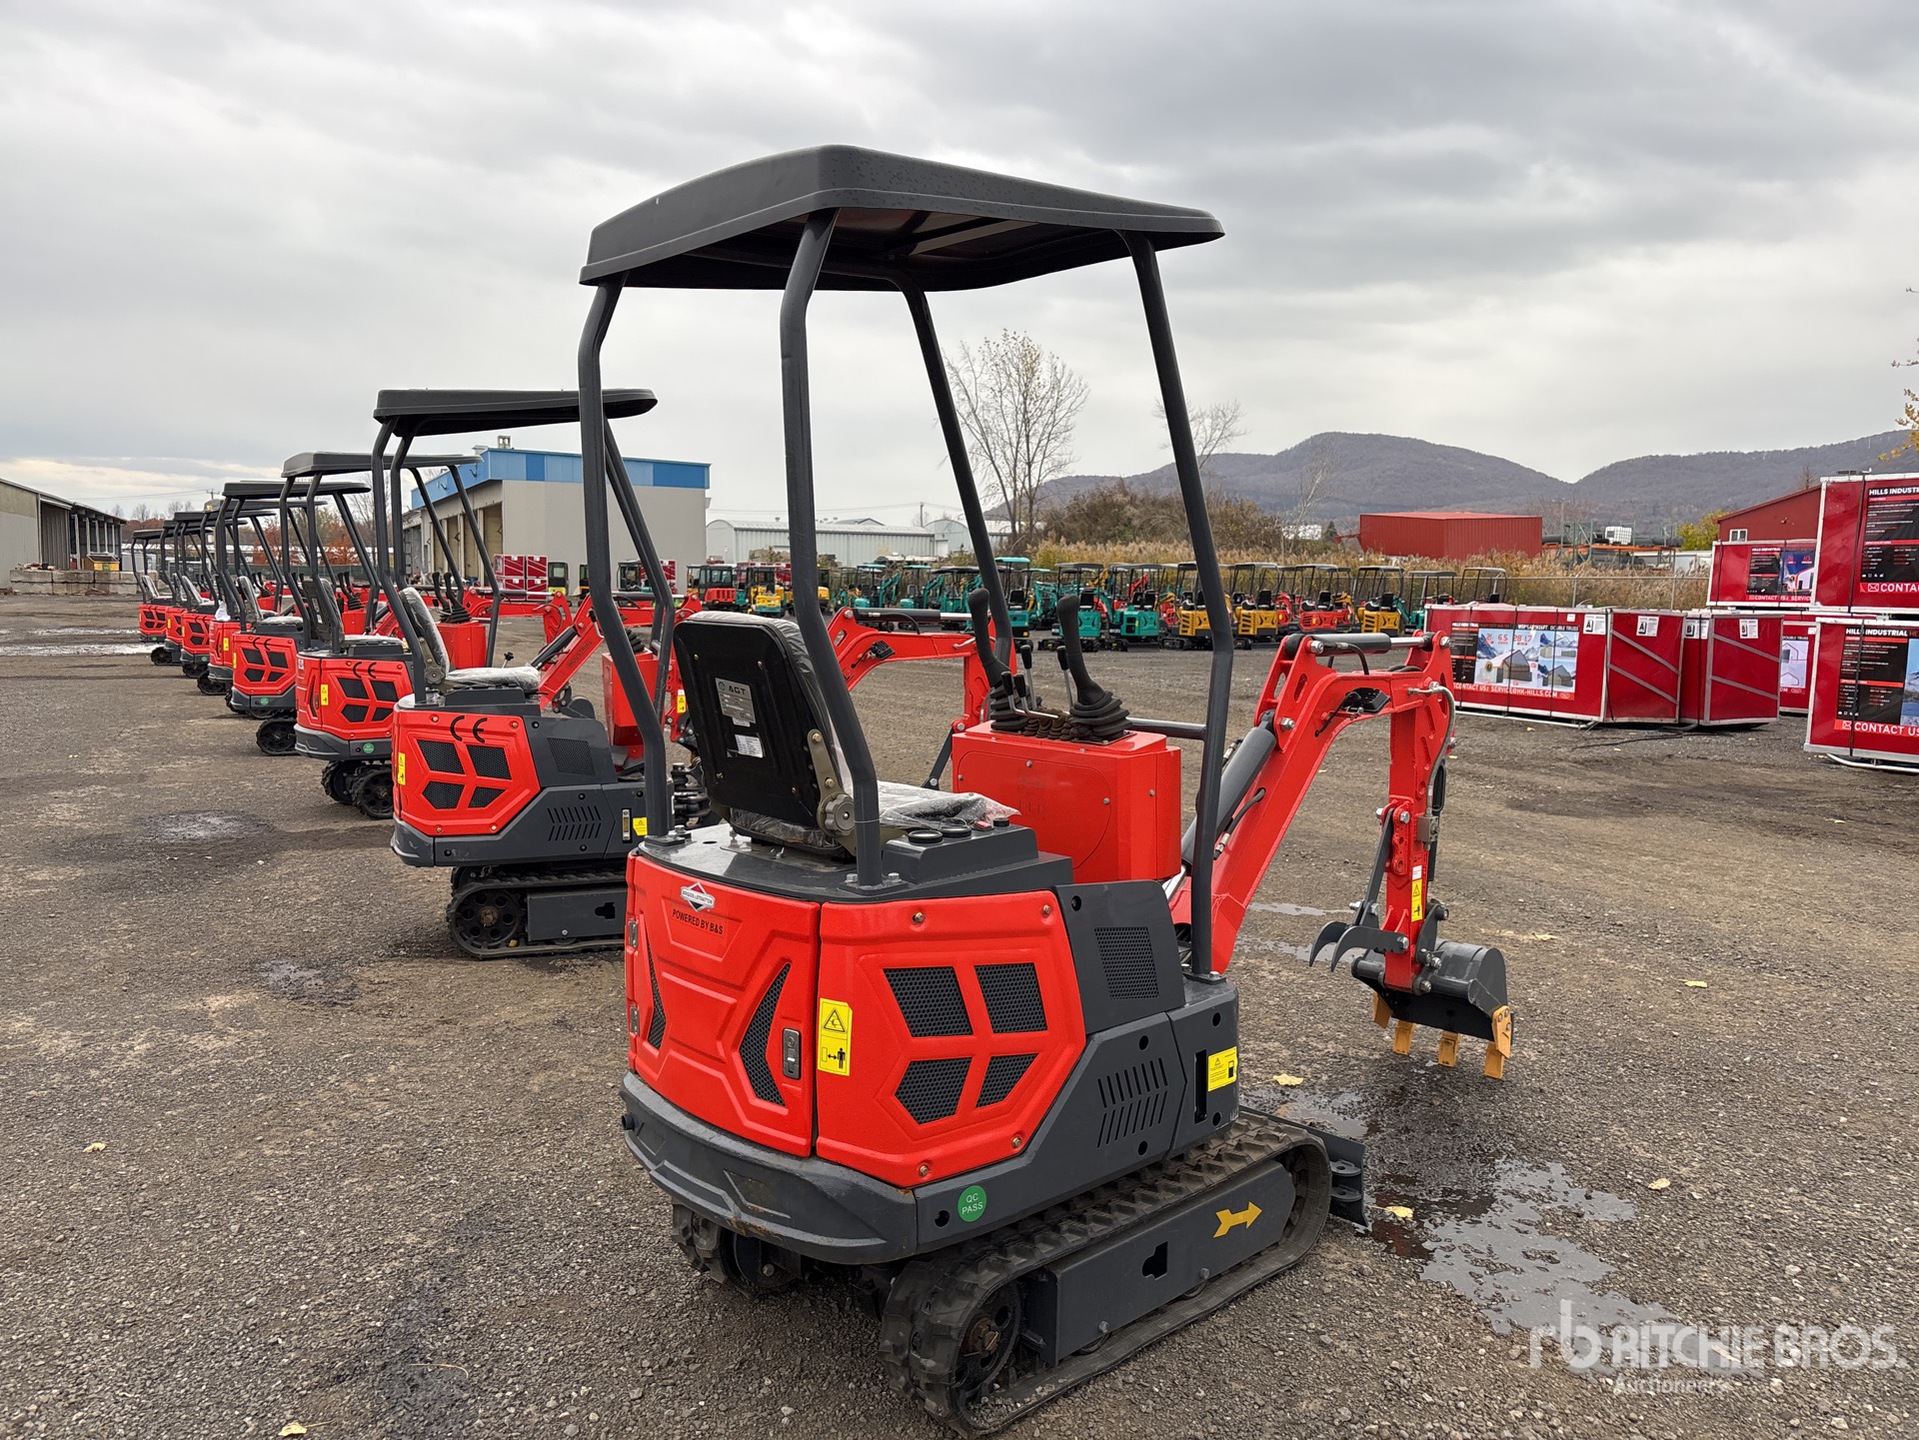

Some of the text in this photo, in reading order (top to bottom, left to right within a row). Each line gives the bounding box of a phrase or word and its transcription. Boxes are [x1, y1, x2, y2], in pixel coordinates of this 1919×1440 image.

[1868, 488, 1888, 496] HILLS
[1880, 582, 1919, 593] CONTA
[1845, 628, 1864, 636] HILL
[1865, 629, 1908, 637] INDUSTRIAL
[728, 685, 747, 695] AGT
[450, 715, 488, 743] CE
[1854, 721, 1904, 735] CONTACT
[672, 909, 723, 935] POWERED BY B&S
[965, 1192, 979, 1203] QC
[961, 1201, 984, 1215] PASS
